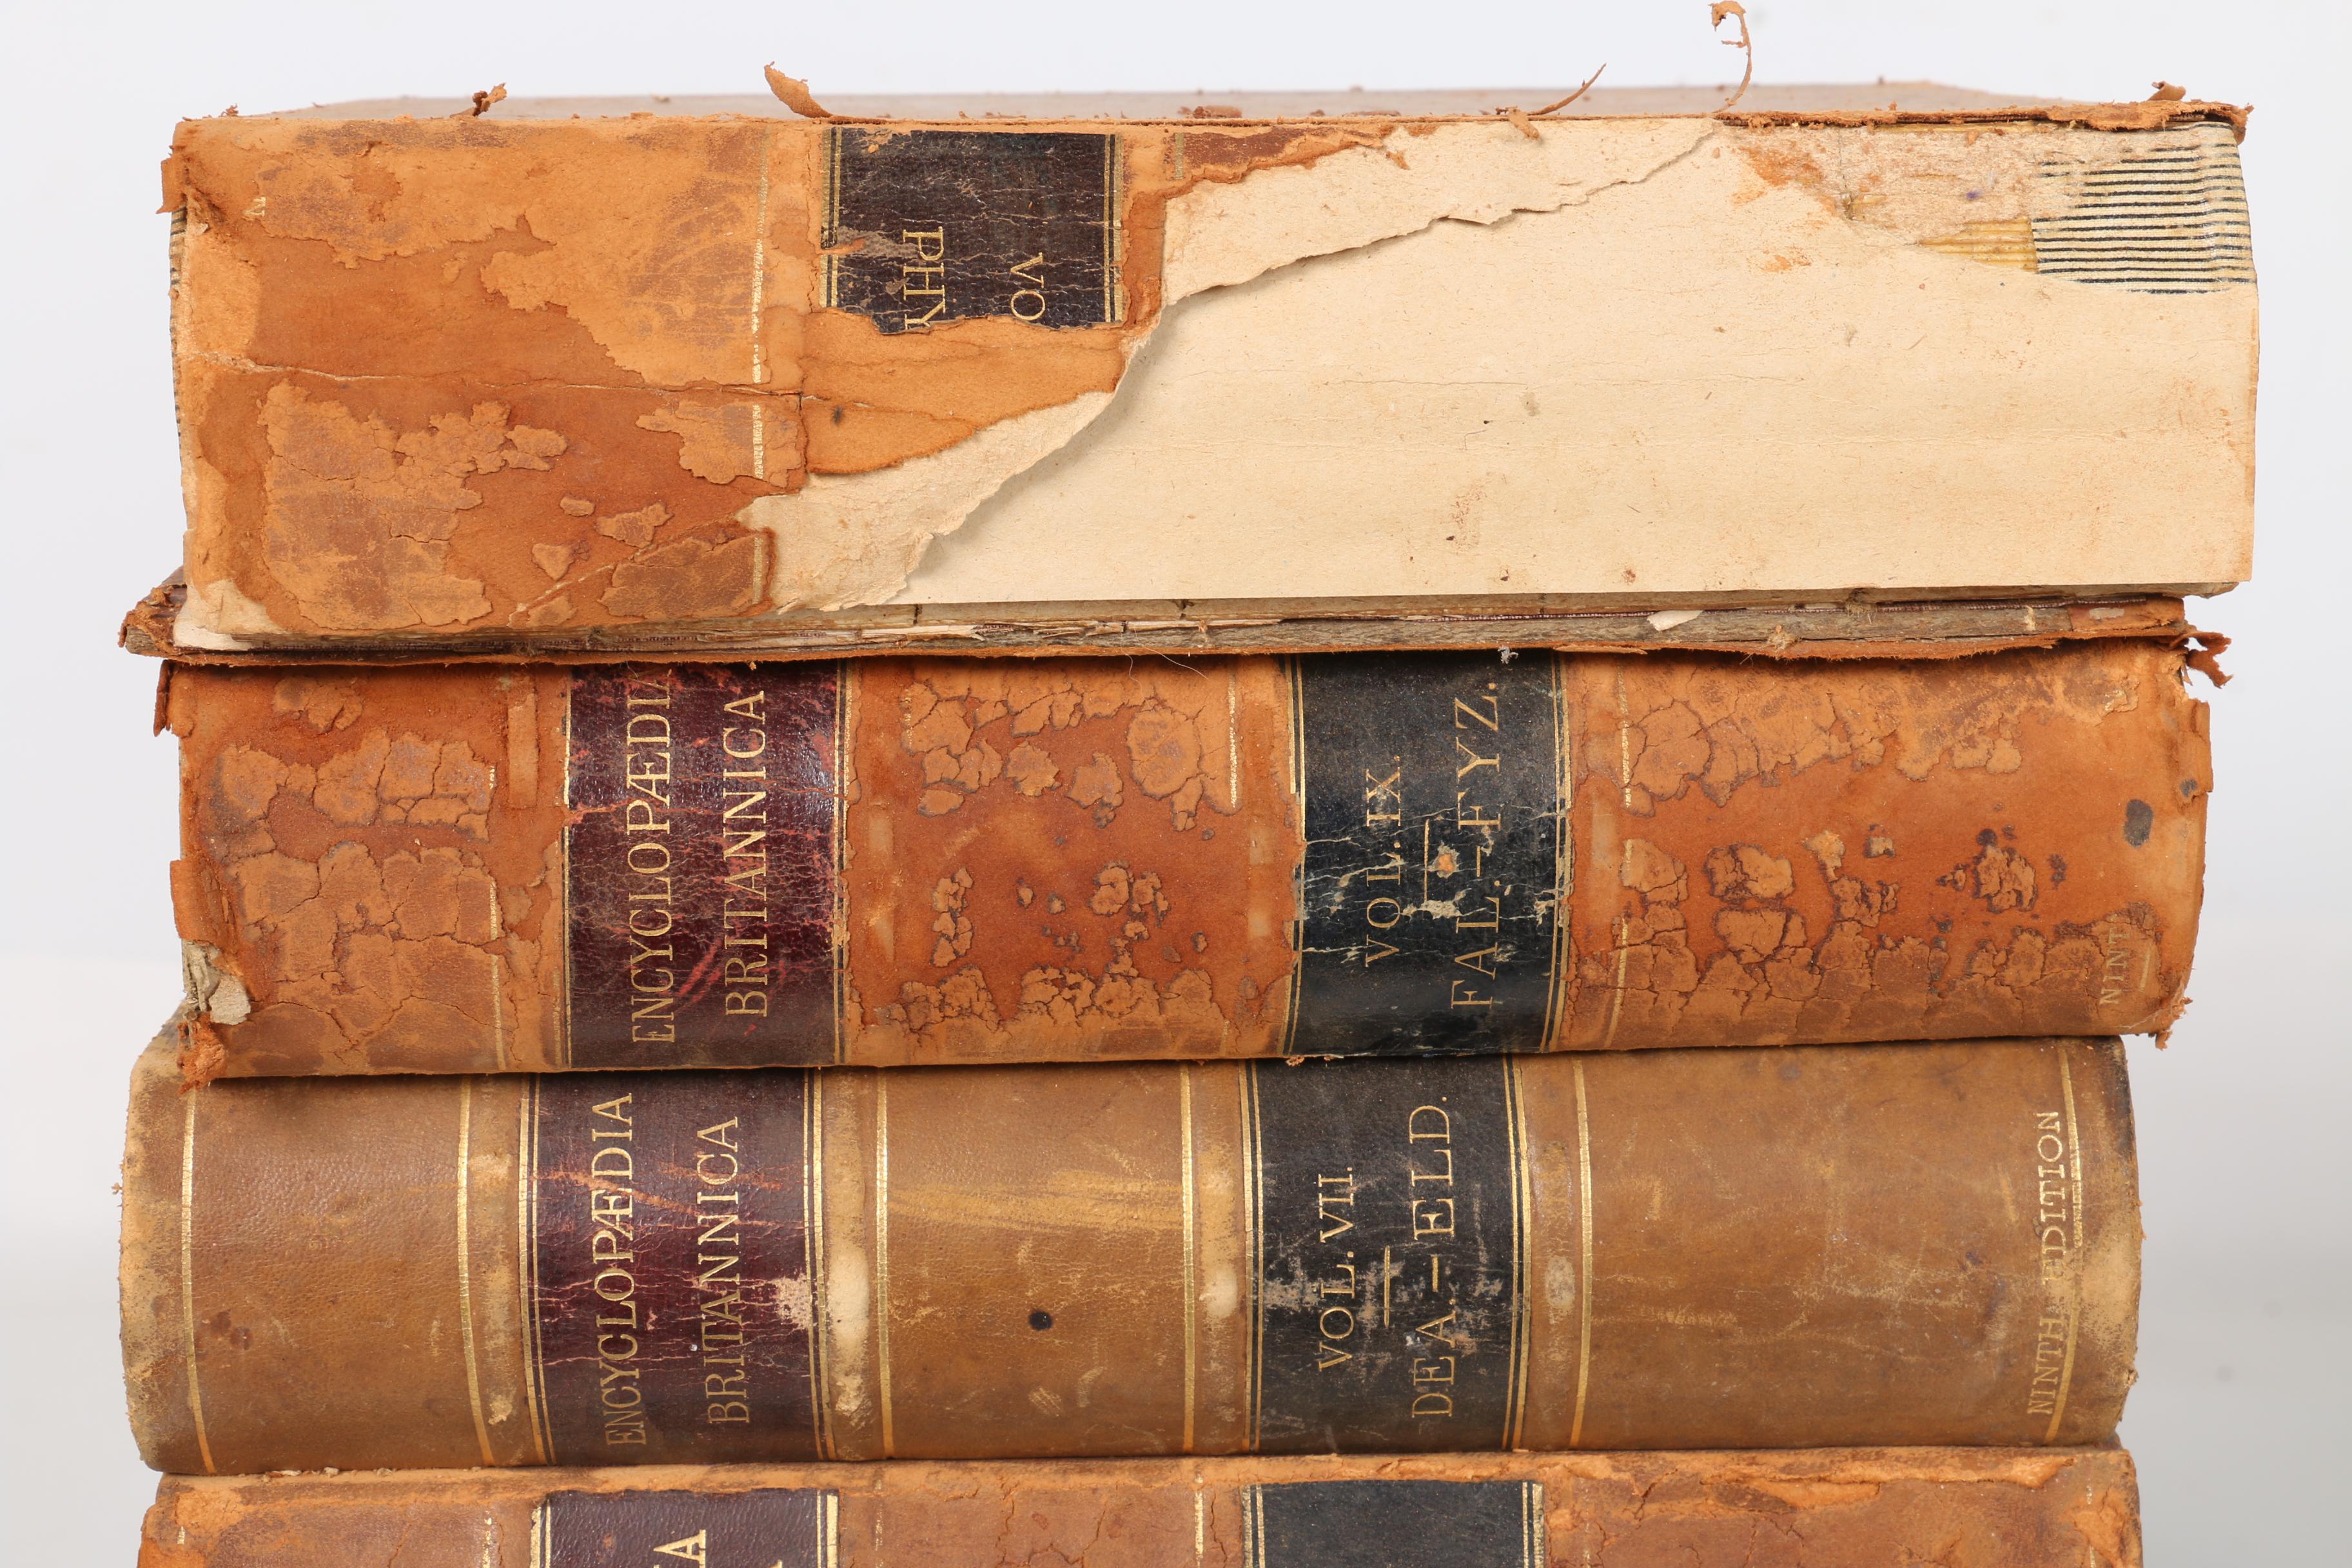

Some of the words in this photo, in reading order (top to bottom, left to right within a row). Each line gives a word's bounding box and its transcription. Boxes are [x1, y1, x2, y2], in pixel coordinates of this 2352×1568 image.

[1365, 755, 1402, 827] IX.
[723, 690, 767, 1017] BRITANNICA
[1365, 841, 1402, 968] VOL.
[1318, 1166, 1355, 1244] VII.
[591, 1092, 646, 1446] ENCYCLOPÆDIA
[697, 1116, 750, 1424] BRITANNICA
[1318, 1251, 1355, 1372] VOL.
[2027, 1316, 2064, 1416] NINTH
